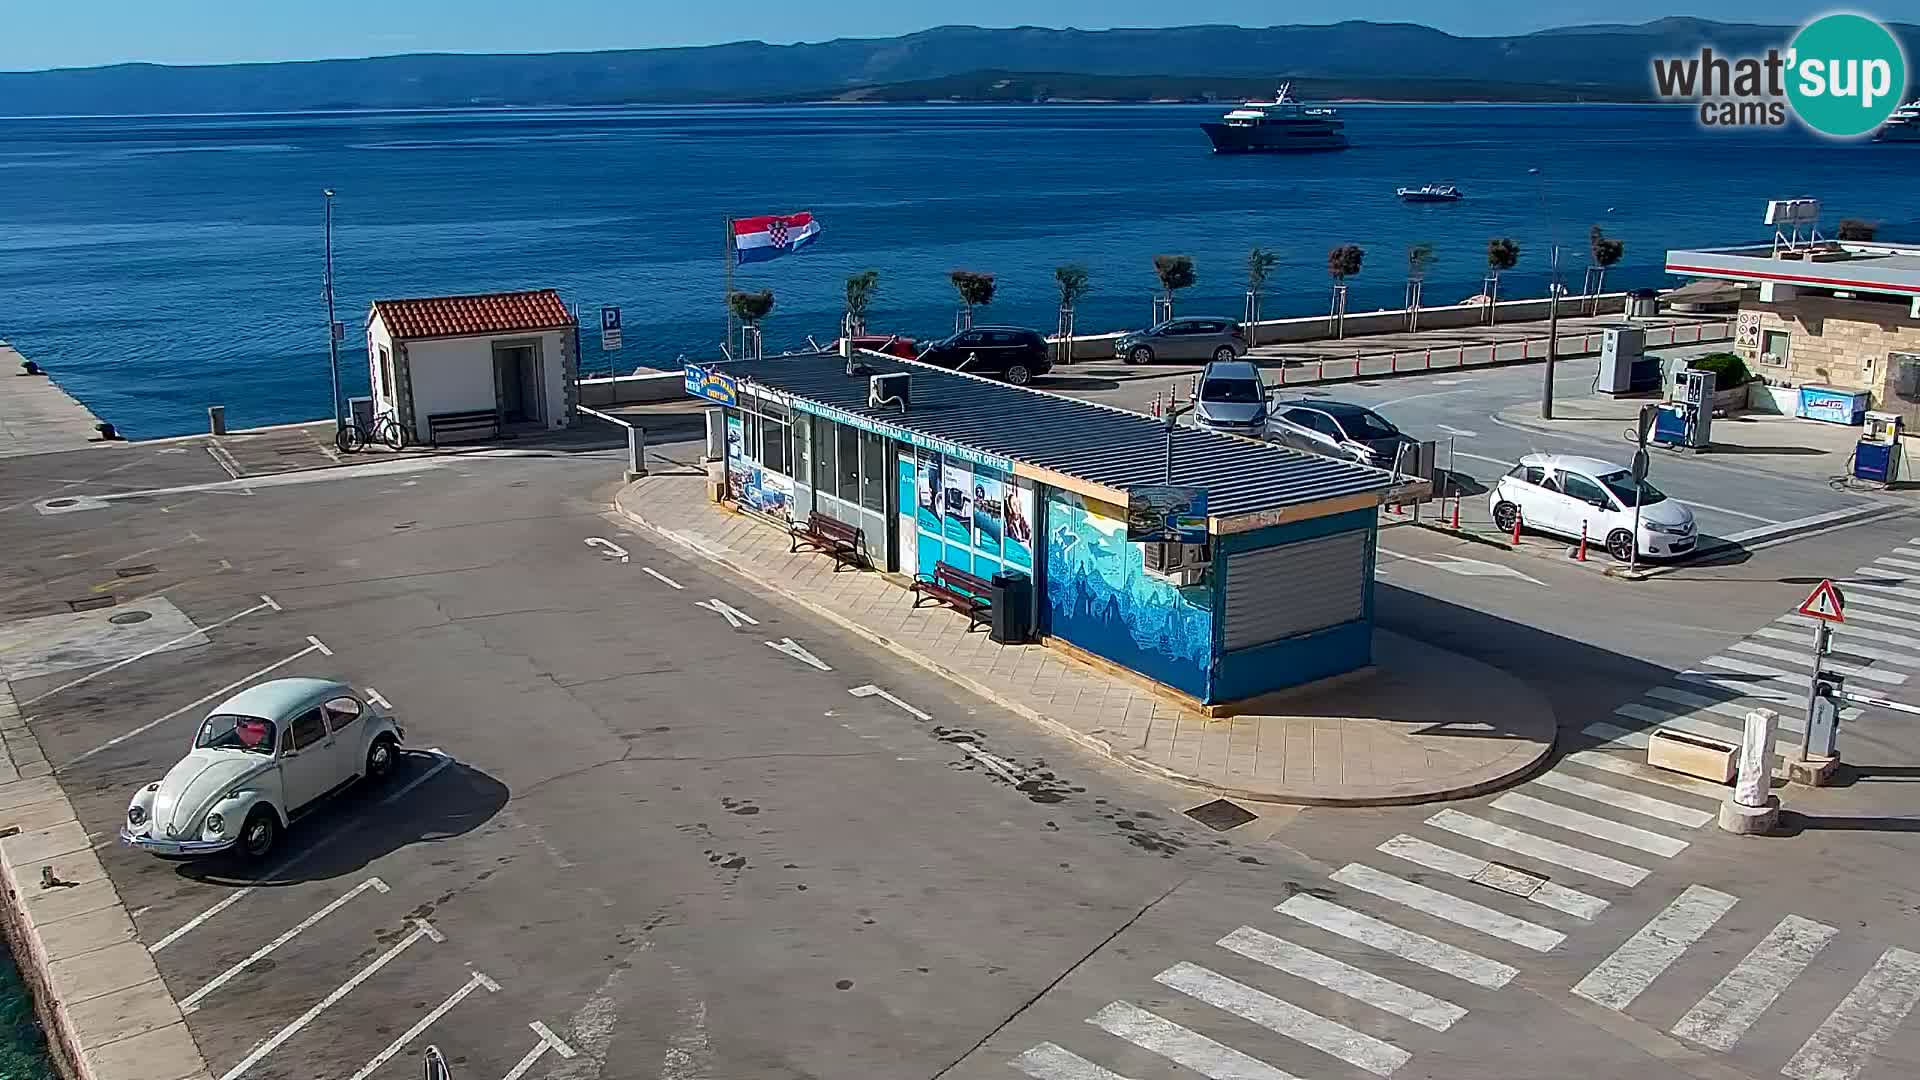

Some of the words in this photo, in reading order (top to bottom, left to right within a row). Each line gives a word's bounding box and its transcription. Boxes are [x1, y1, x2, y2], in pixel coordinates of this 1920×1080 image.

[606, 310, 616, 327] P
[793, 399, 815, 413] PRODAJA
[836, 411, 873, 430] AUTOBUSNA
[874, 423, 902, 439] POSTAJA
[911, 432, 925, 447] BUS
[926, 438, 957, 455] STATION
[959, 448, 983, 464] TICKET
[983, 455, 1009, 471] OFFICE
